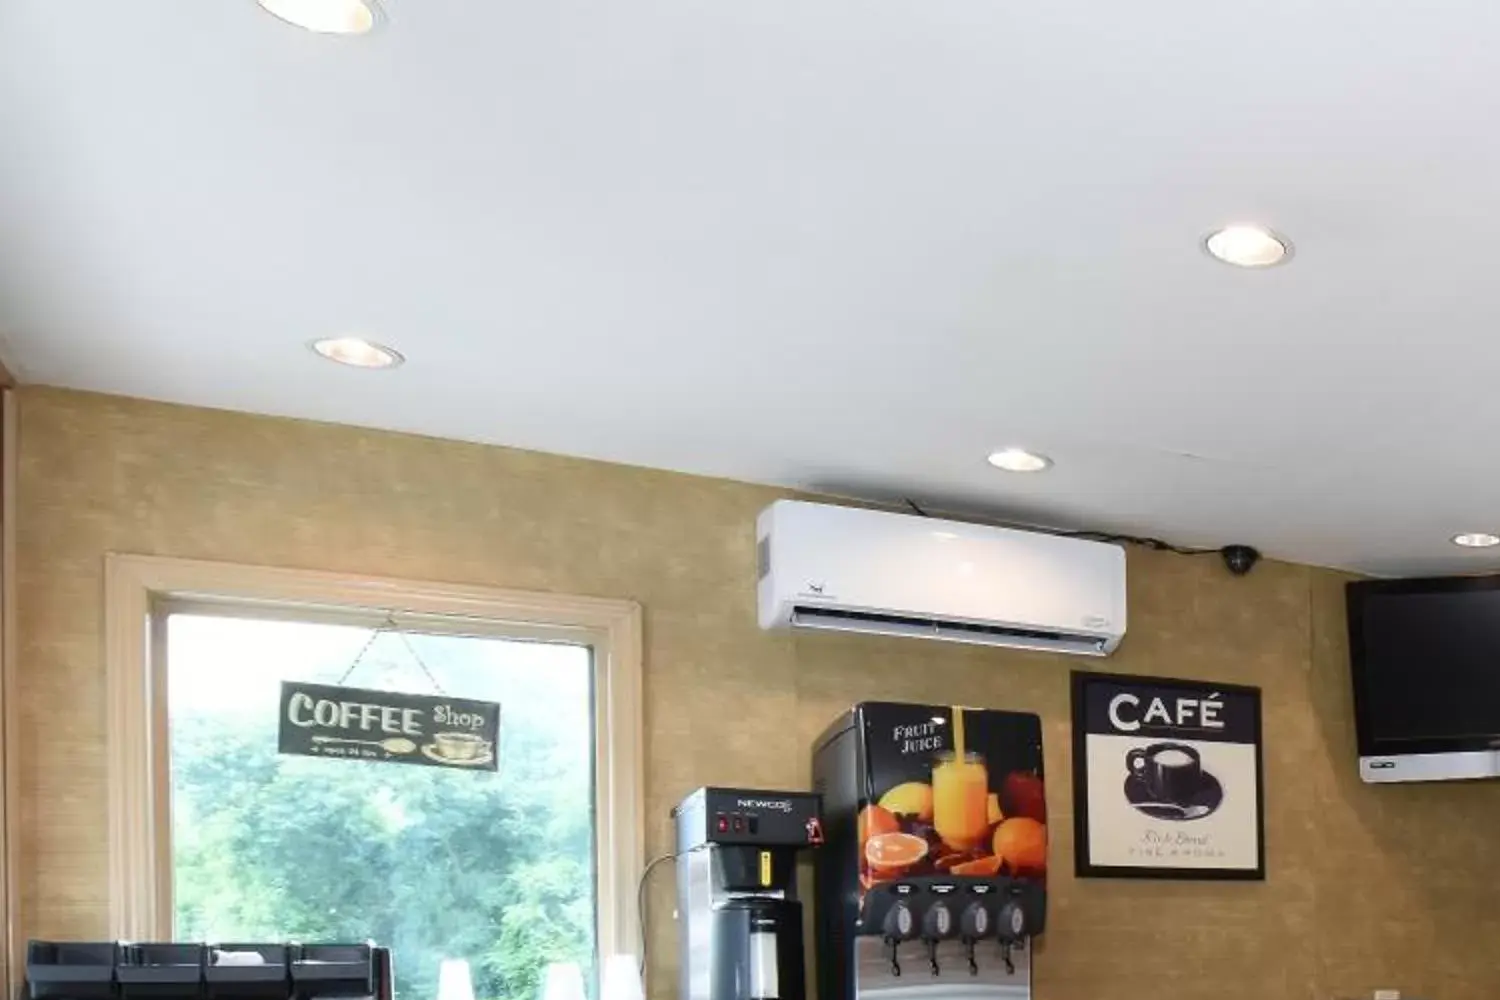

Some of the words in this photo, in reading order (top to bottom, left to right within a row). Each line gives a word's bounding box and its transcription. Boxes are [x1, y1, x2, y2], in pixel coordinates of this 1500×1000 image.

[288, 691, 425, 736] COFFEE
[433, 704, 485, 730] Shop
[1108, 692, 1226, 732] CAFÉ
[893, 722, 937, 742] FRUIT
[901, 735, 943, 754] JUICE
